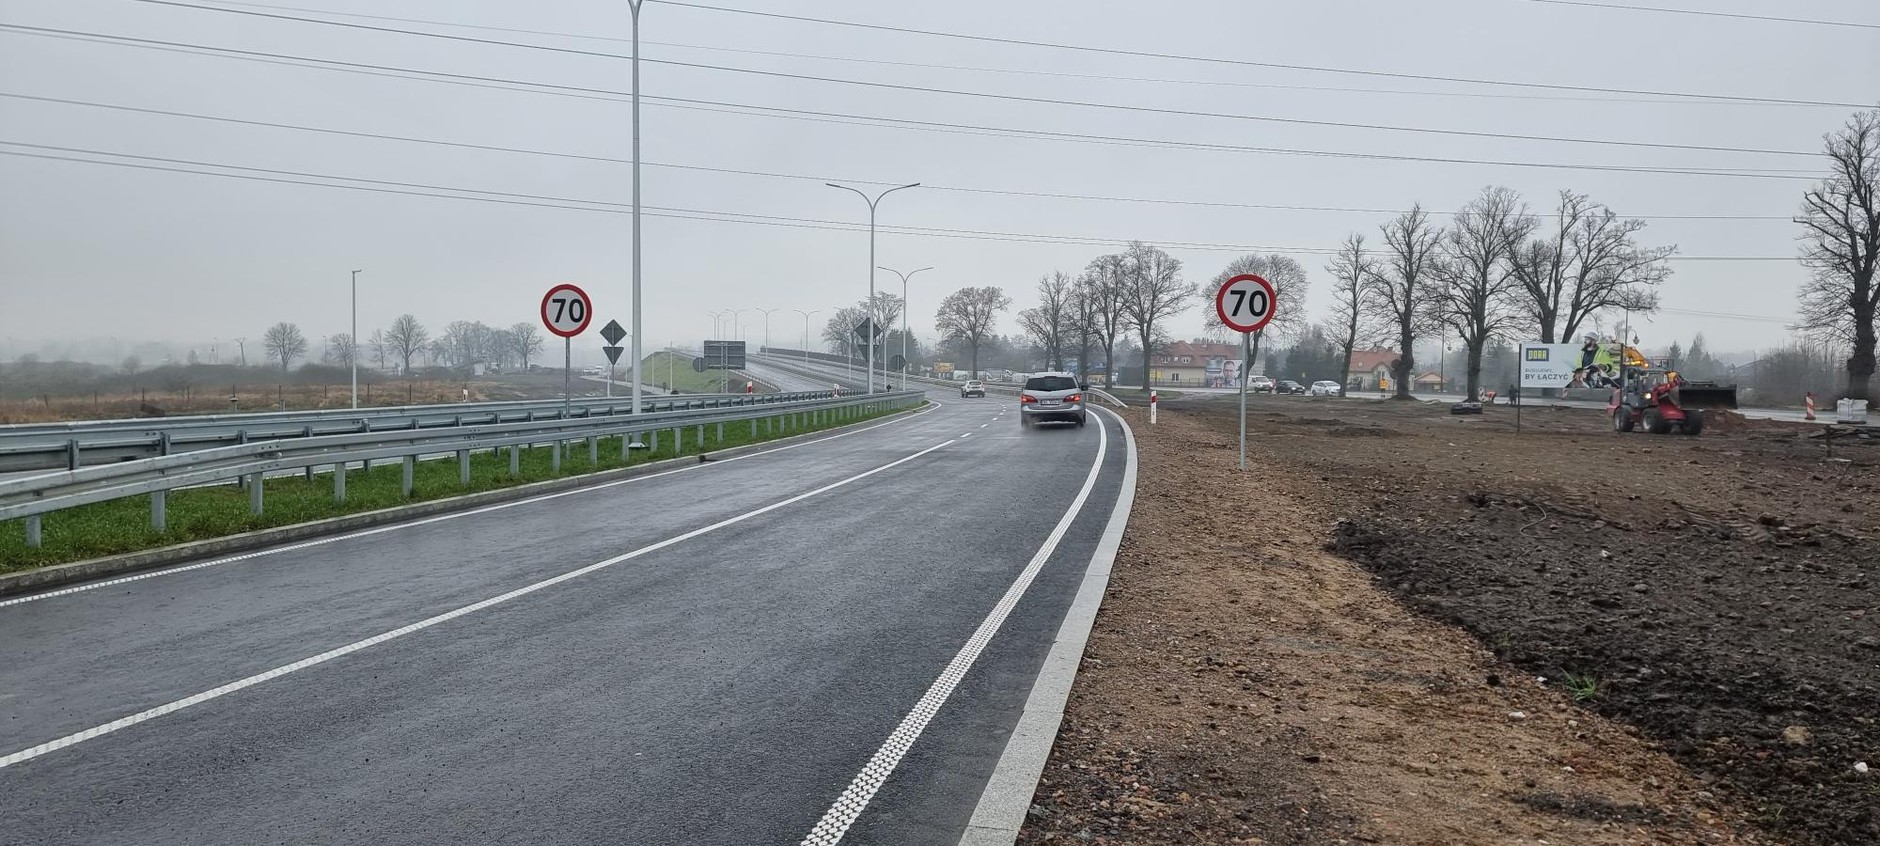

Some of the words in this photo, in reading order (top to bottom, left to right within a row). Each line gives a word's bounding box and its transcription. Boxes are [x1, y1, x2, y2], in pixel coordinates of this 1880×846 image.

[552, 298, 584, 323] 70
[1230, 290, 1267, 317] 70
[1537, 373, 1569, 381] ŁĄCZYĆ
